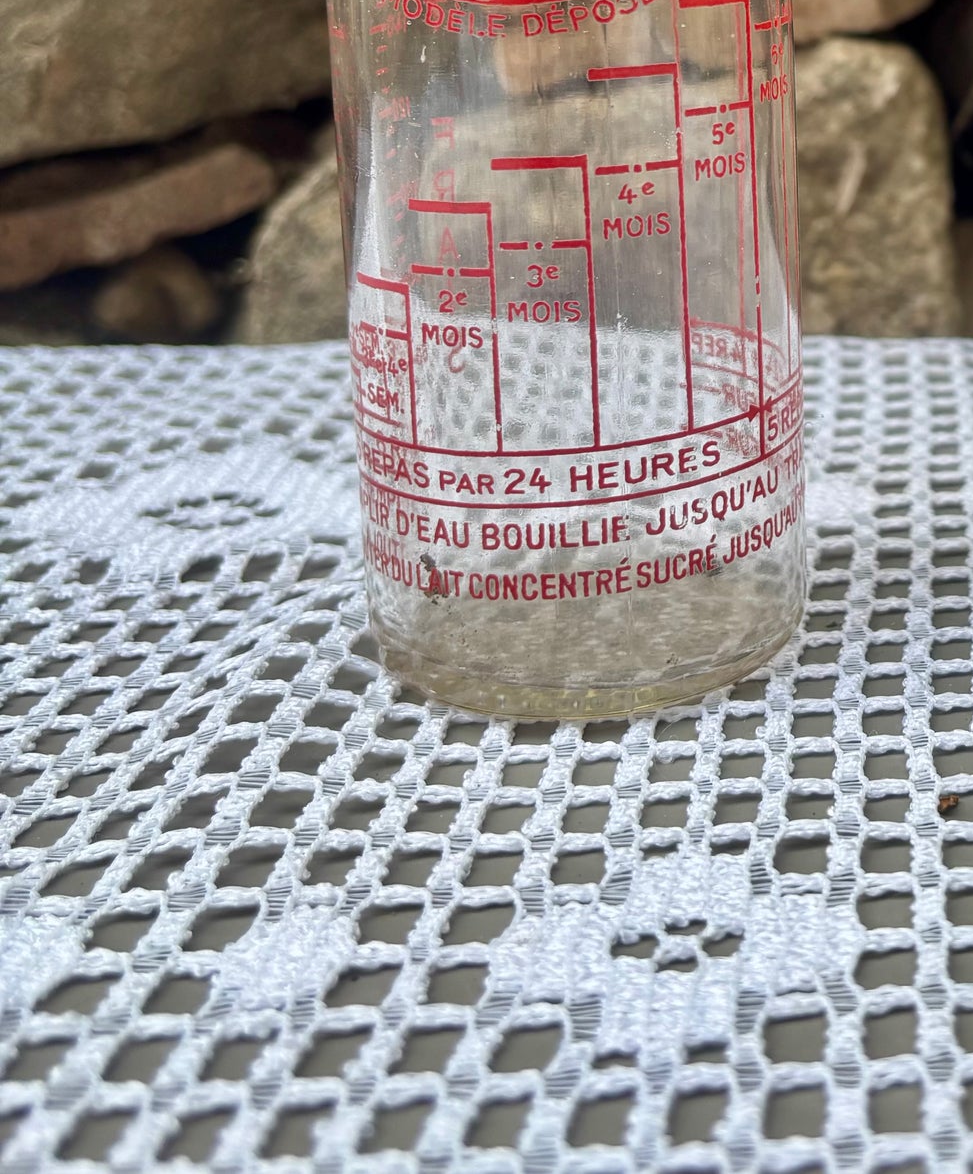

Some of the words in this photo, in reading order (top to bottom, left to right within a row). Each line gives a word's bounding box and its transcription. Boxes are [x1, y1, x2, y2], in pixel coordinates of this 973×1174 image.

[759, 74, 789, 103] MOIS
[712, 121, 736, 145] 5e
[695, 152, 746, 181] MOIS
[618, 181, 655, 205] 4e
[603, 212, 671, 240] MOIS
[526, 264, 560, 288] 3e
[439, 289, 467, 313] 2e
[507, 301, 582, 323] MOIS
[421, 323, 484, 348] MOIS
[363, 441, 430, 488] REPAS
[439, 470, 495, 495] PAR
[504, 468, 552, 494] 24
[570, 440, 721, 493] HEURES
[396, 508, 470, 548] D'EAU
[482, 515, 631, 551] BOUILLIE
[645, 466, 779, 535] JUSQU'AU
[416, 563, 464, 598] LAIT
[469, 557, 632, 601] CONCENTRÉ
[637, 534, 719, 588] SUCRÉ
[723, 502, 798, 564] JUSQU'AU
